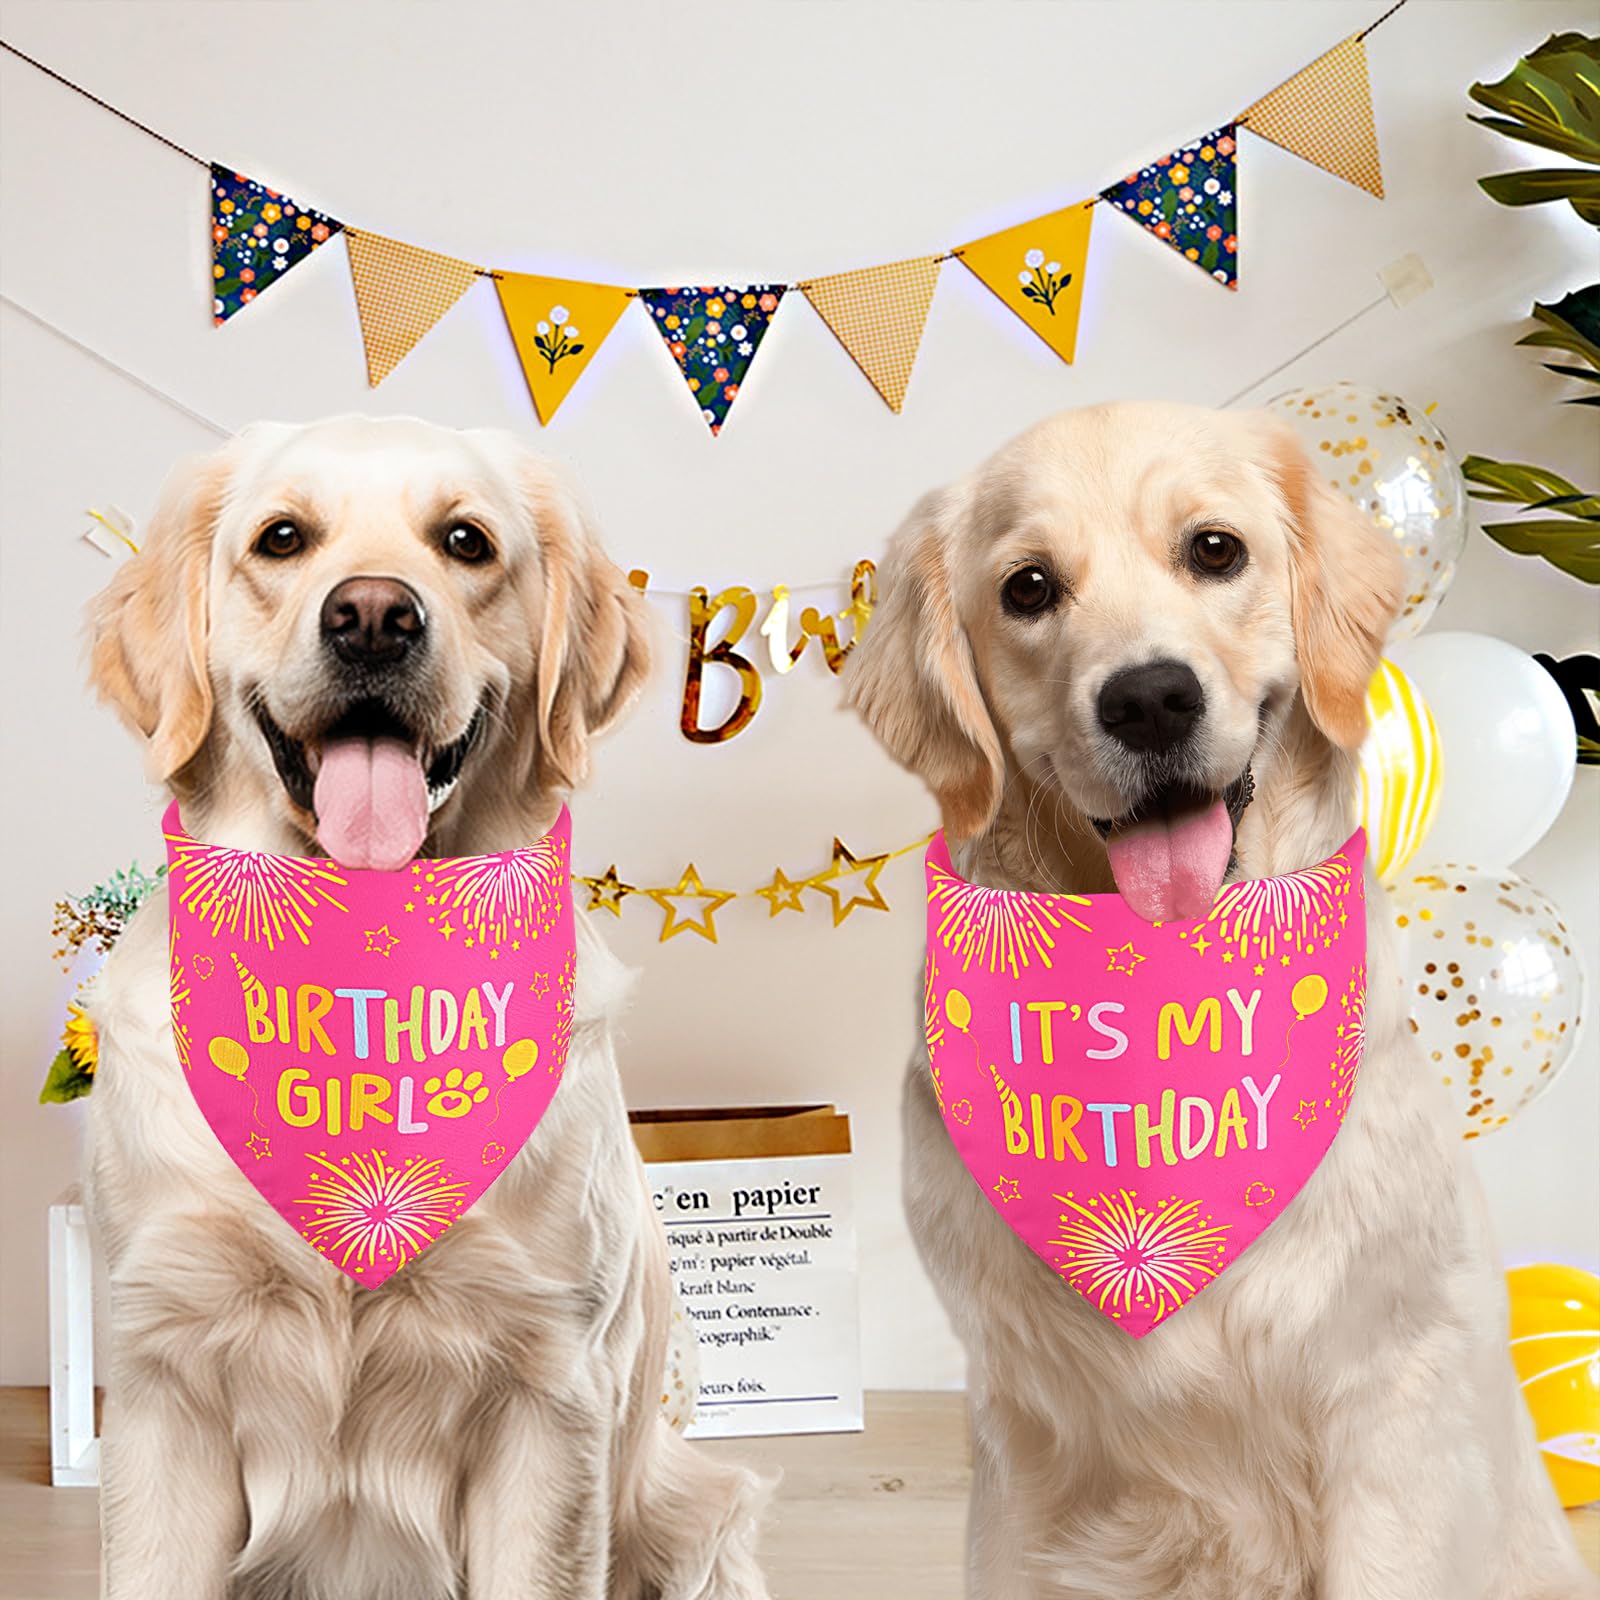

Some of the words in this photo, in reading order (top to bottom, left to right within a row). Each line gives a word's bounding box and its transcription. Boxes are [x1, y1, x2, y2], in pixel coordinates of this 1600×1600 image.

[243, 980, 515, 1064] BIRTHDAY
[1157, 988, 1262, 1061] MY
[276, 1068, 429, 1136] GIRL
[1001, 1073, 1282, 1169] BIRTHDAY
[676, 1189, 710, 1210] en
[733, 1181, 820, 1216] papier
[717, 1228, 756, 1248] partir
[760, 1226, 777, 1241] de
[780, 1222, 833, 1240] Double
[679, 1280, 713, 1296] kraft
[717, 1279, 756, 1295] blanc
[710, 1253, 756, 1272] papier
